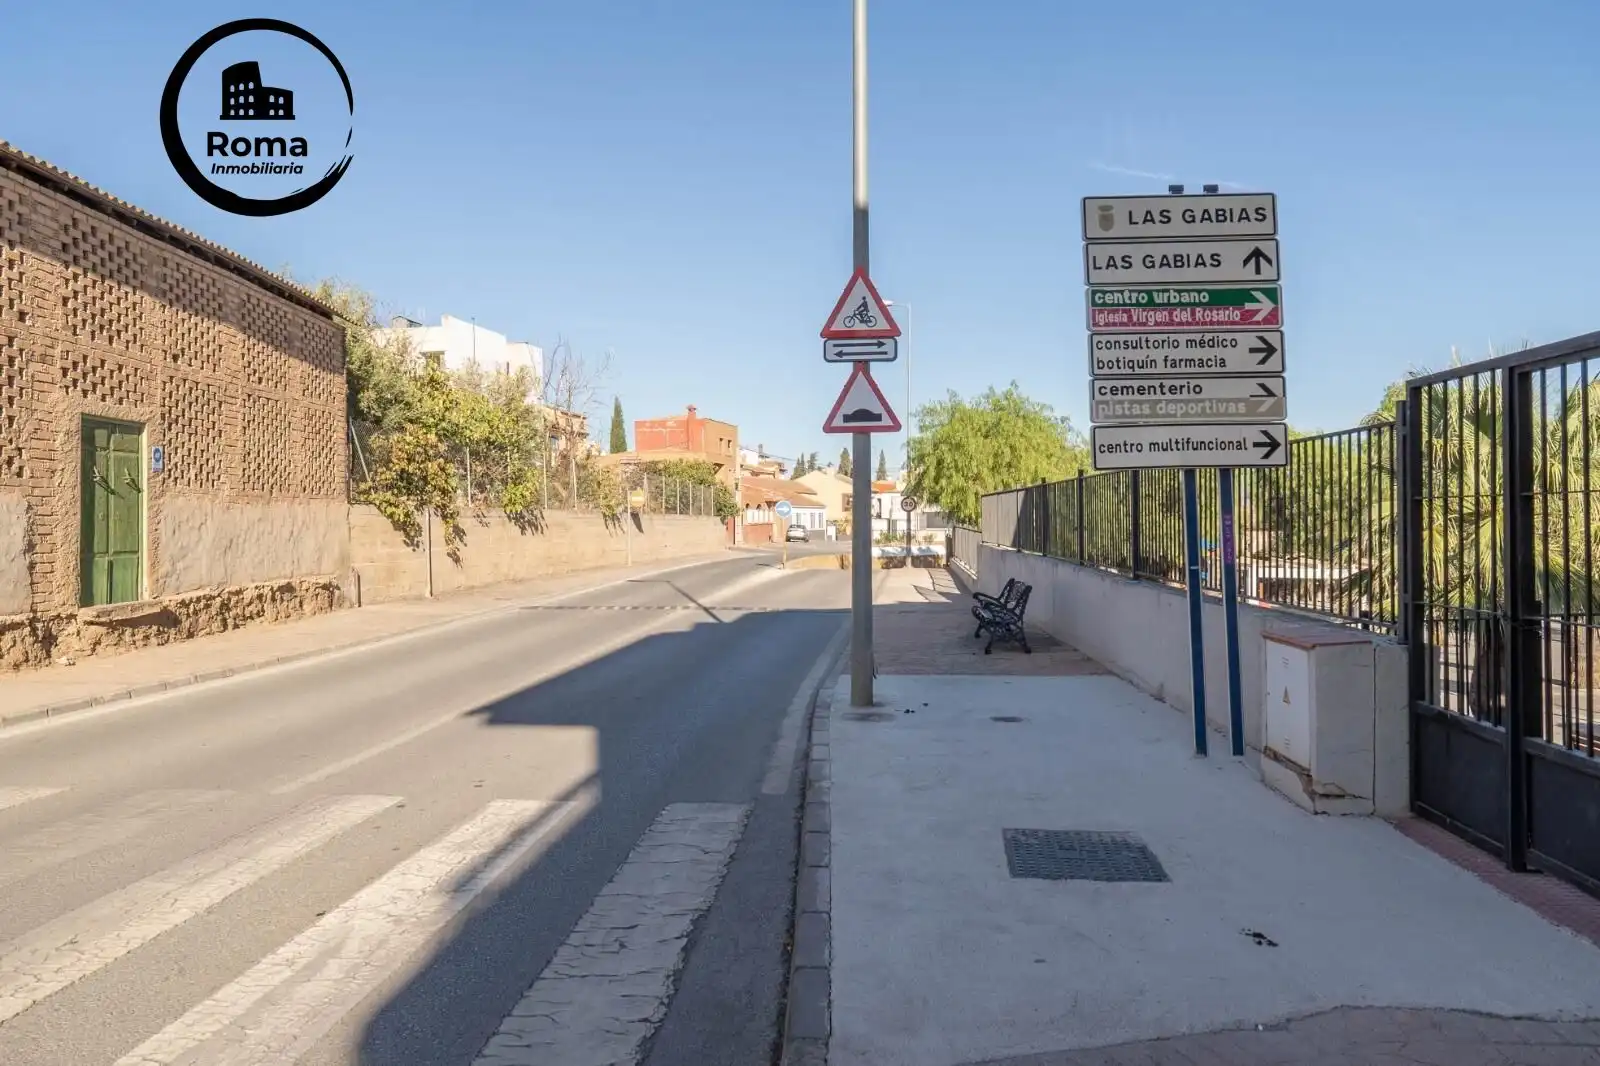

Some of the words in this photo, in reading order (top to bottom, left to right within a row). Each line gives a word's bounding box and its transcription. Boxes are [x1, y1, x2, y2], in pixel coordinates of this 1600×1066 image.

[1128, 209, 1172, 225] LAS
[1181, 207, 1267, 224] GABIAS
[1092, 255, 1133, 270] LAS
[1142, 253, 1222, 269] GABIAS
[1094, 290, 1148, 304] centro
[1152, 289, 1210, 303] urbano
[1130, 308, 1169, 325] Virgen
[1173, 307, 1192, 322] del
[1195, 306, 1240, 322] Rosario
[1095, 335, 1180, 351] consultorio
[1185, 334, 1238, 349] médico
[1096, 354, 1157, 372] botiquín
[1163, 355, 1227, 369] farmacia
[1098, 381, 1203, 396] cementerio
[1099, 401, 1150, 418] pistas
[1156, 400, 1246, 417] deportivas
[1099, 440, 1143, 454] centro
[1149, 437, 1248, 453] multifuncional
